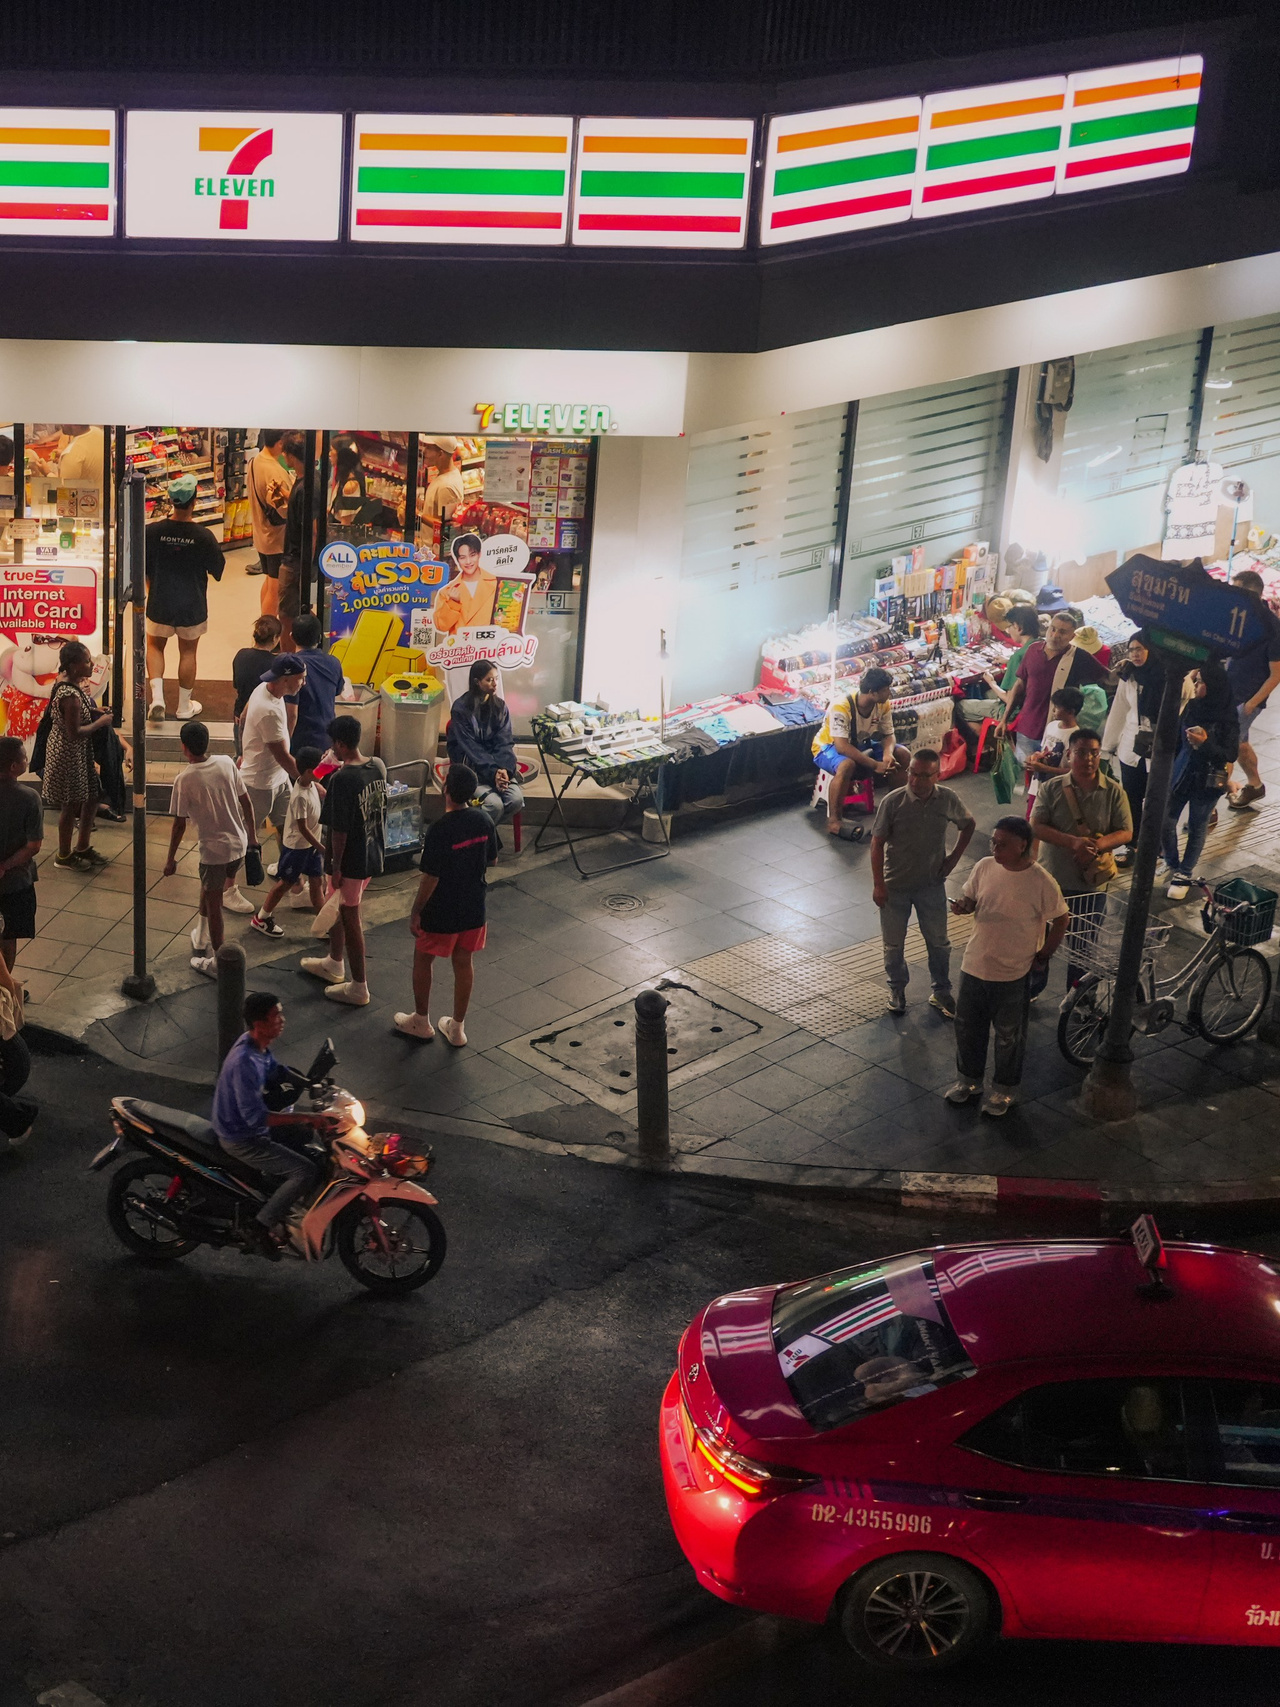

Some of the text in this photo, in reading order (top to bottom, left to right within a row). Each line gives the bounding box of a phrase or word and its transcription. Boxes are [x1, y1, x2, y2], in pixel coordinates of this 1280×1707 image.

[160, 535, 195, 545] MONTANA
[326, 552, 354, 563] ALL
[3, 588, 65, 601] Internet
[1130, 569, 1192, 605] สุขุมวิท
[34, 603, 82, 619] Card
[340, 592, 410, 614] 2,000,000
[50, 620, 77, 630] Here
[1229, 606, 1248, 639] 11
[811, 1503, 932, 1534] 02-4355996
